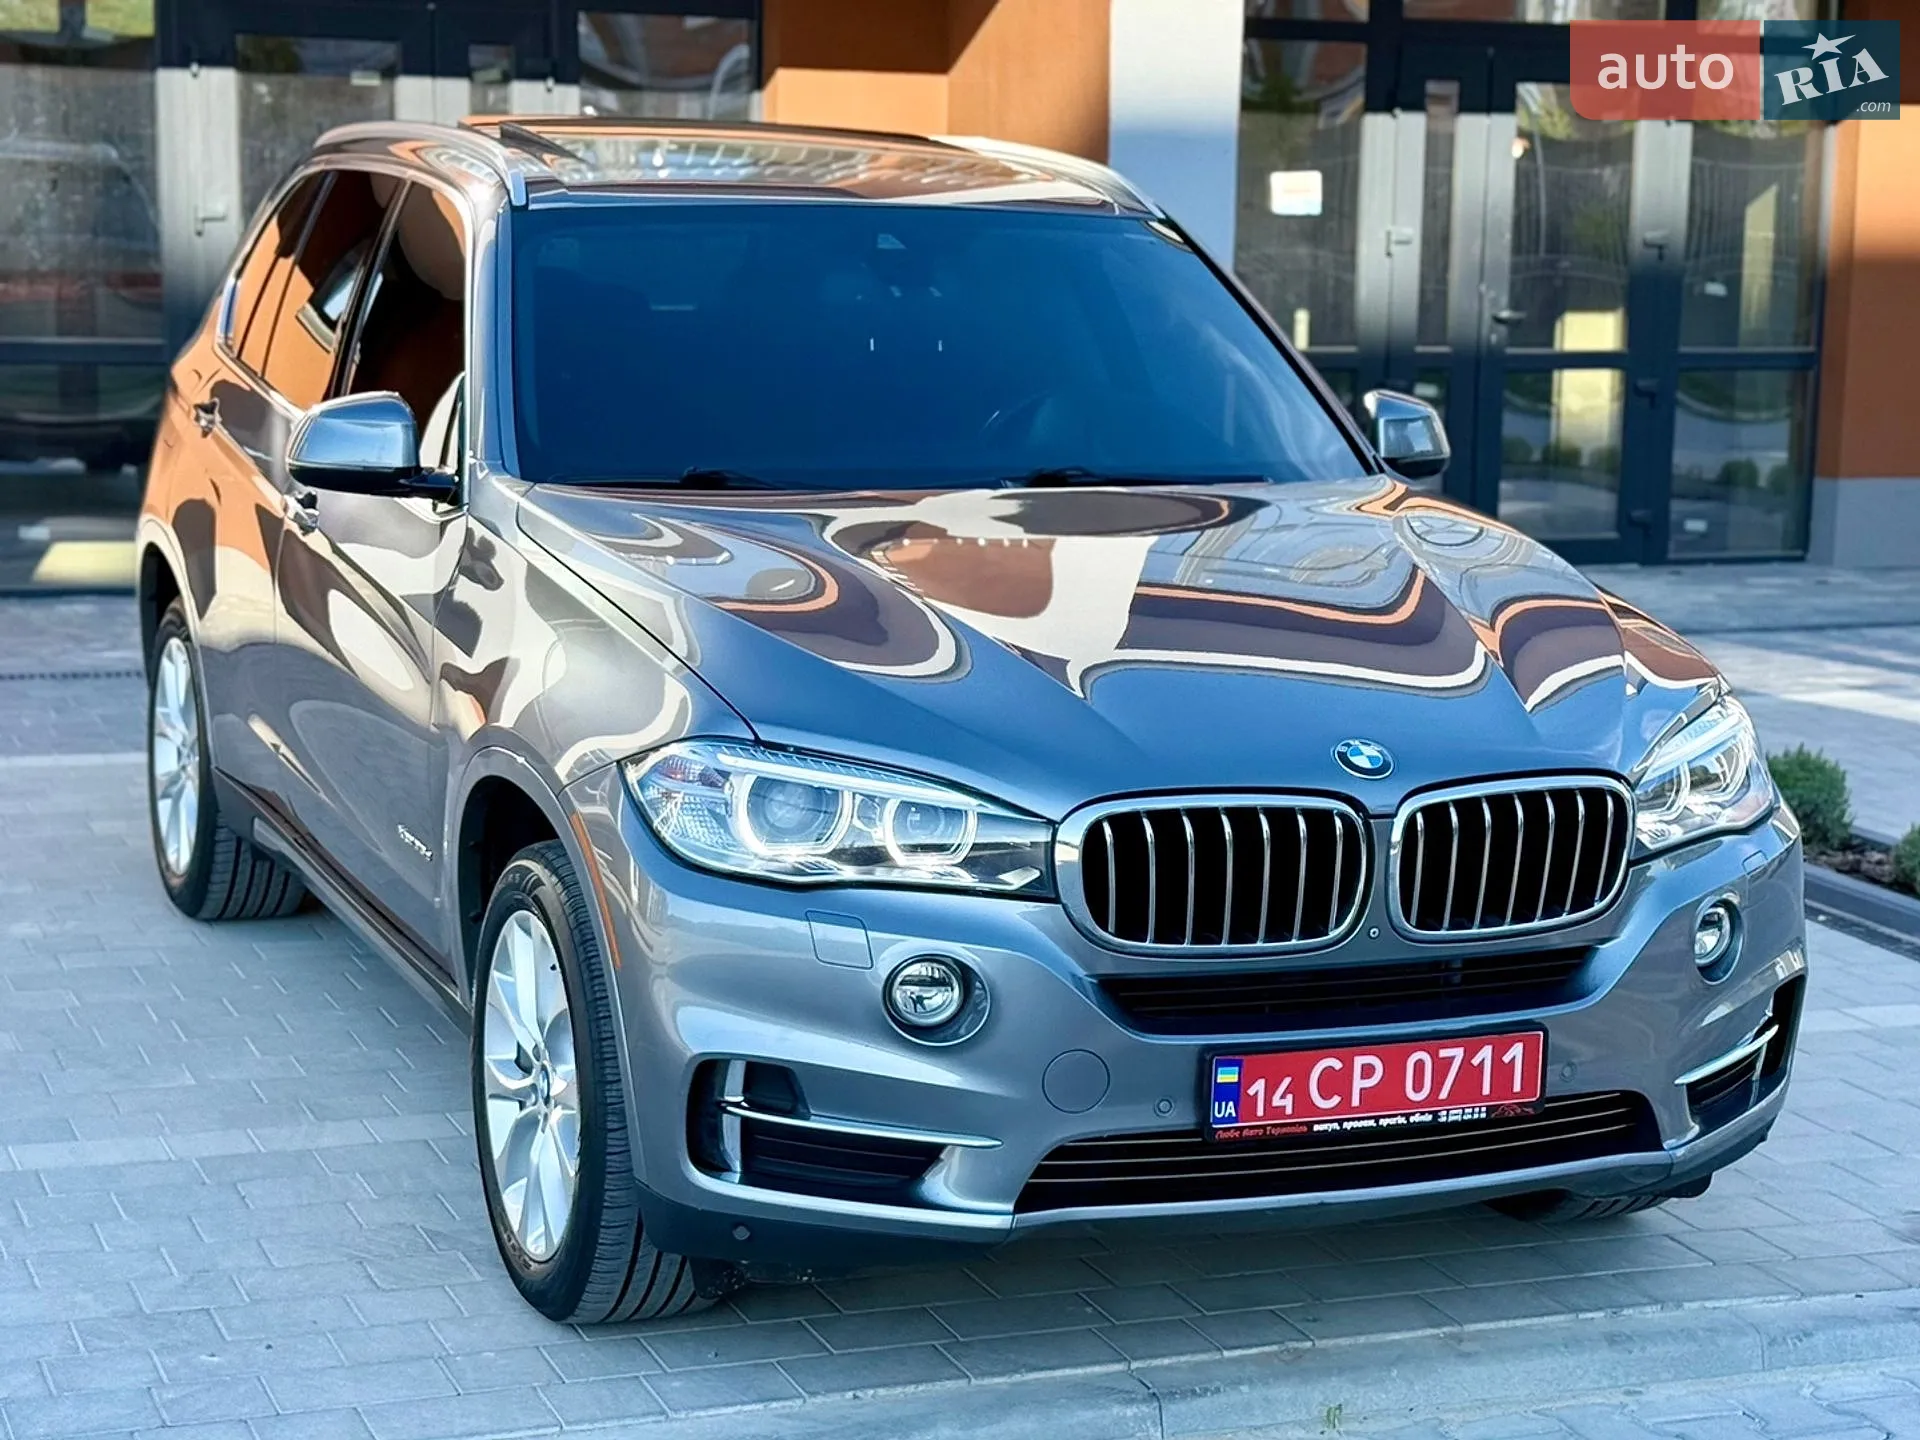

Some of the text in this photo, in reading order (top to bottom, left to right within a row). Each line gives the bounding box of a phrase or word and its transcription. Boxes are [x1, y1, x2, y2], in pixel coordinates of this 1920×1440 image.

[1246, 1042, 1525, 1118] 14 CP 0711
[1214, 1100, 1237, 1118] UA
